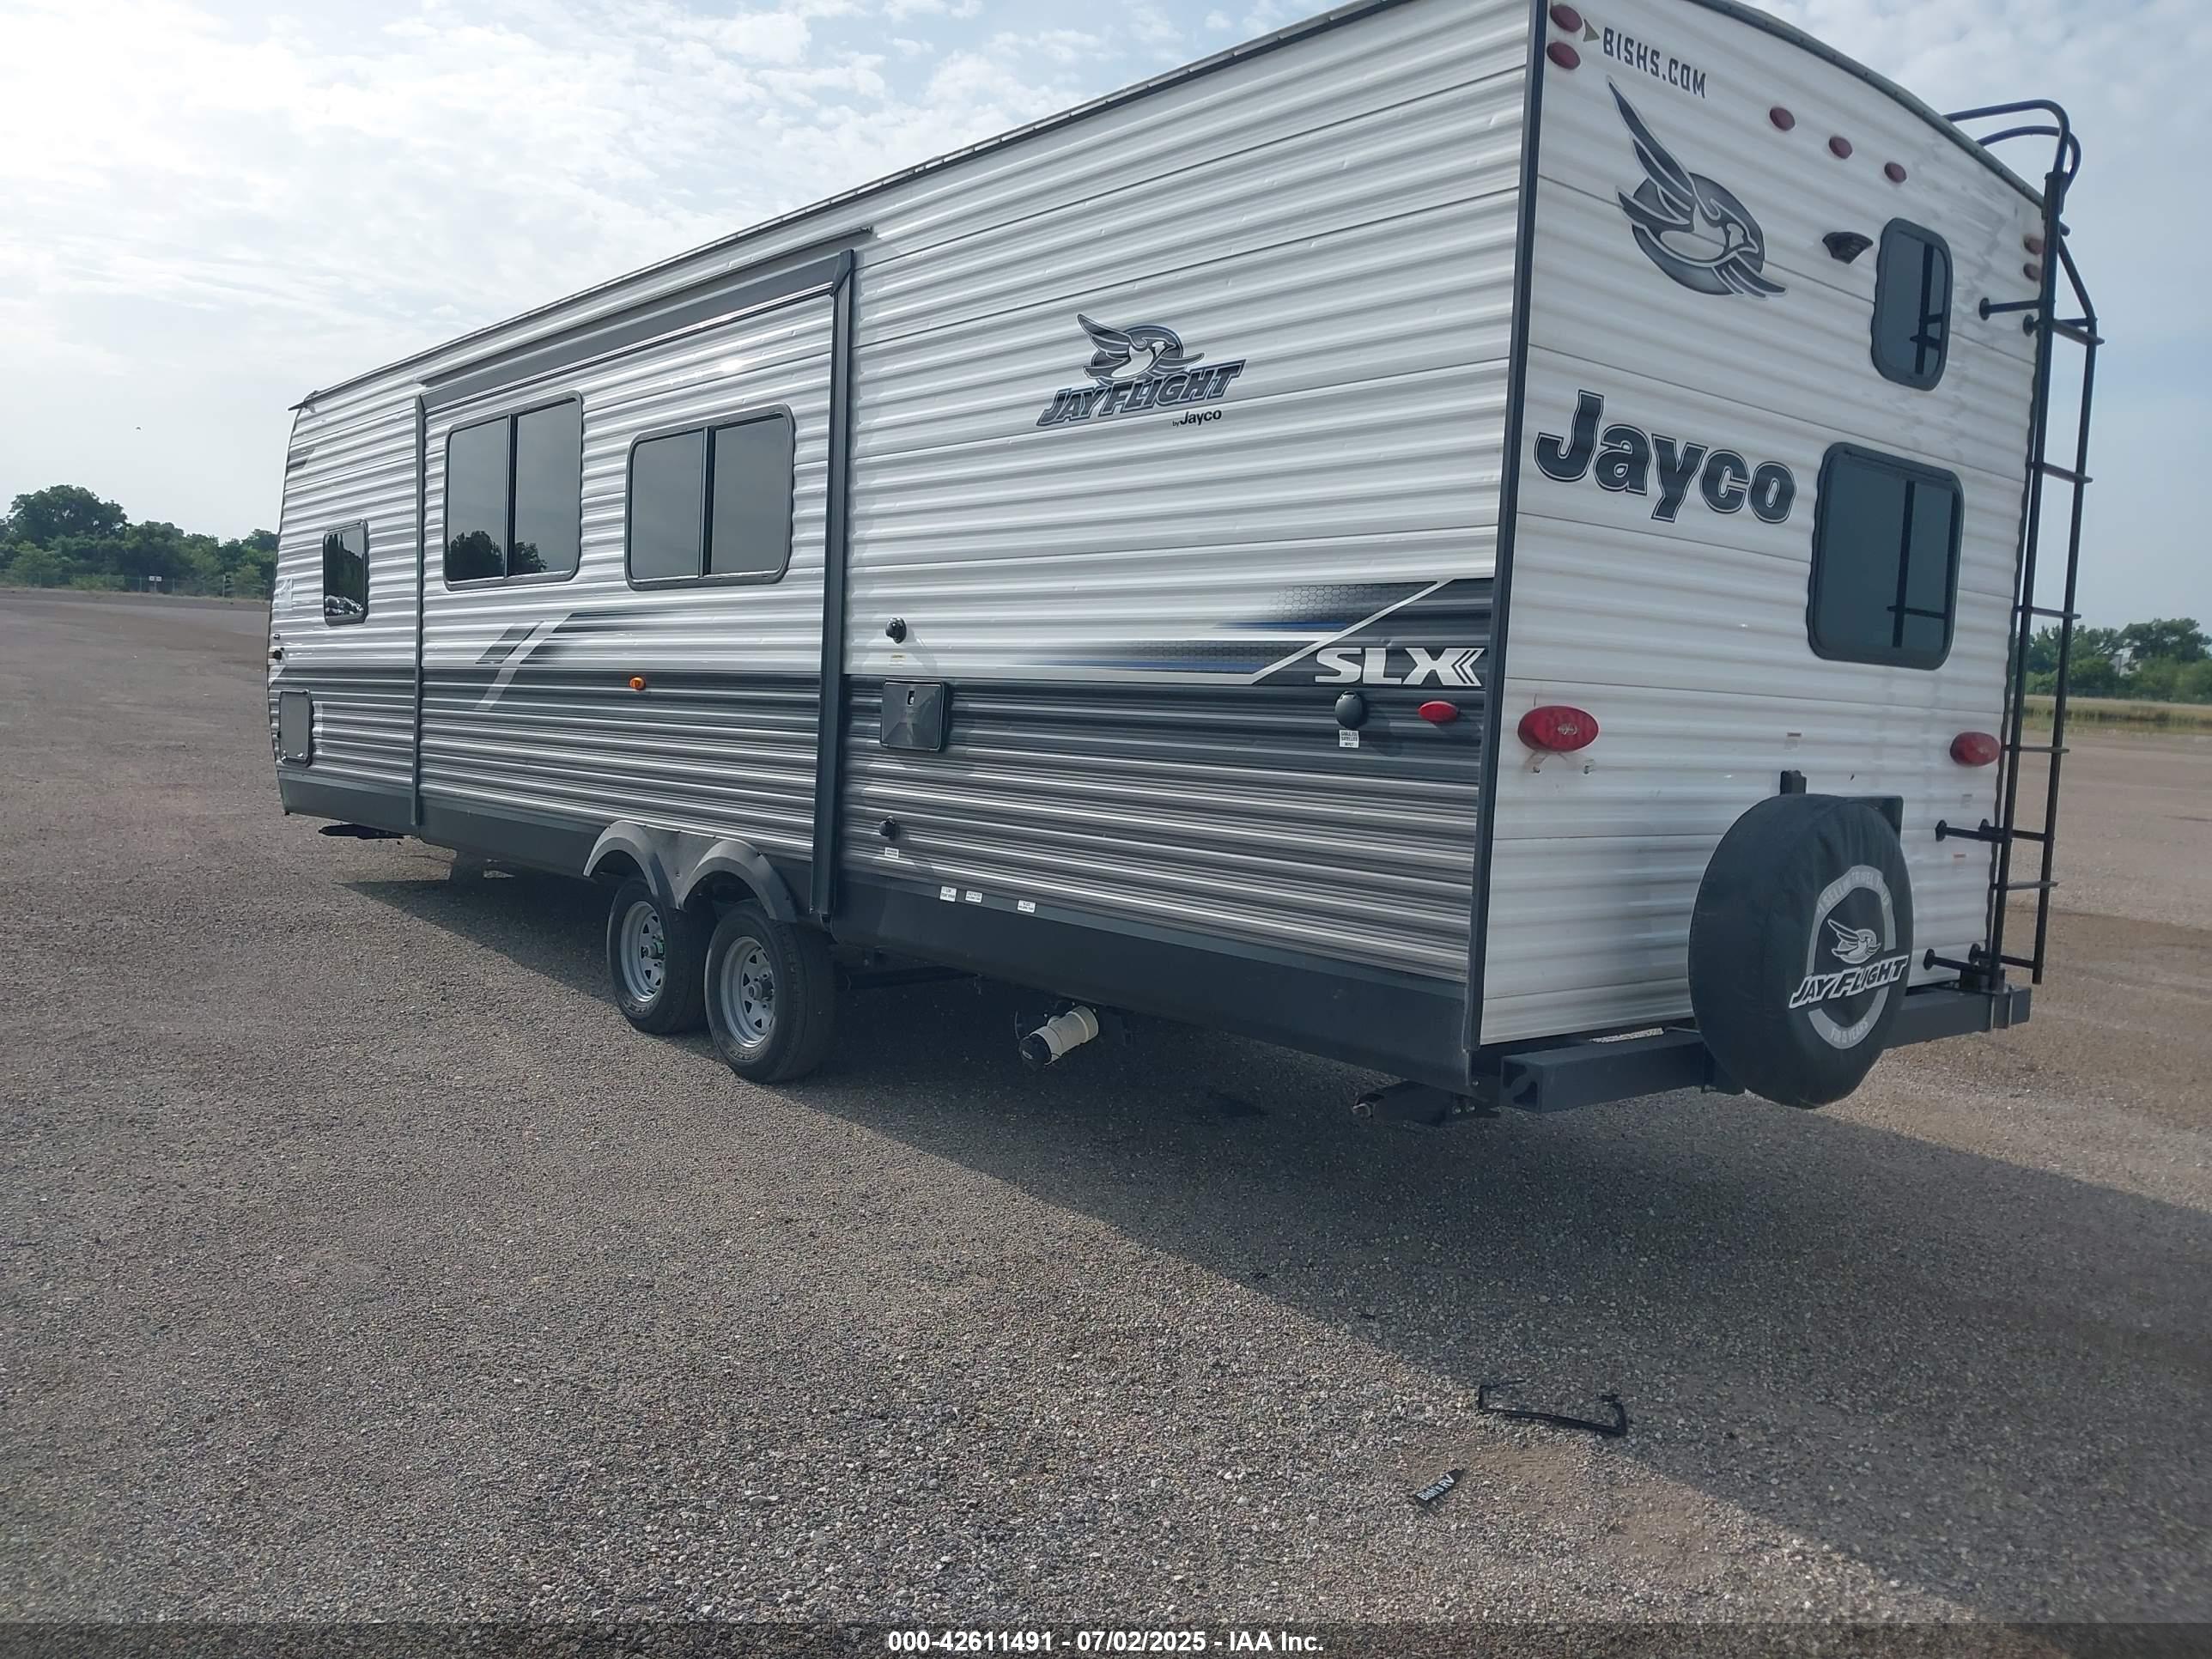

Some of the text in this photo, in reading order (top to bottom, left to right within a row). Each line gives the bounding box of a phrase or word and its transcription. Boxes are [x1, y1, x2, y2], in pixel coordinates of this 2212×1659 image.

[1603, 27, 1706, 99] BISHS.COM
[1180, 409, 1223, 427] Jayco
[1534, 389, 1797, 524] Jayco
[1437, 1474, 1455, 1489] RV
